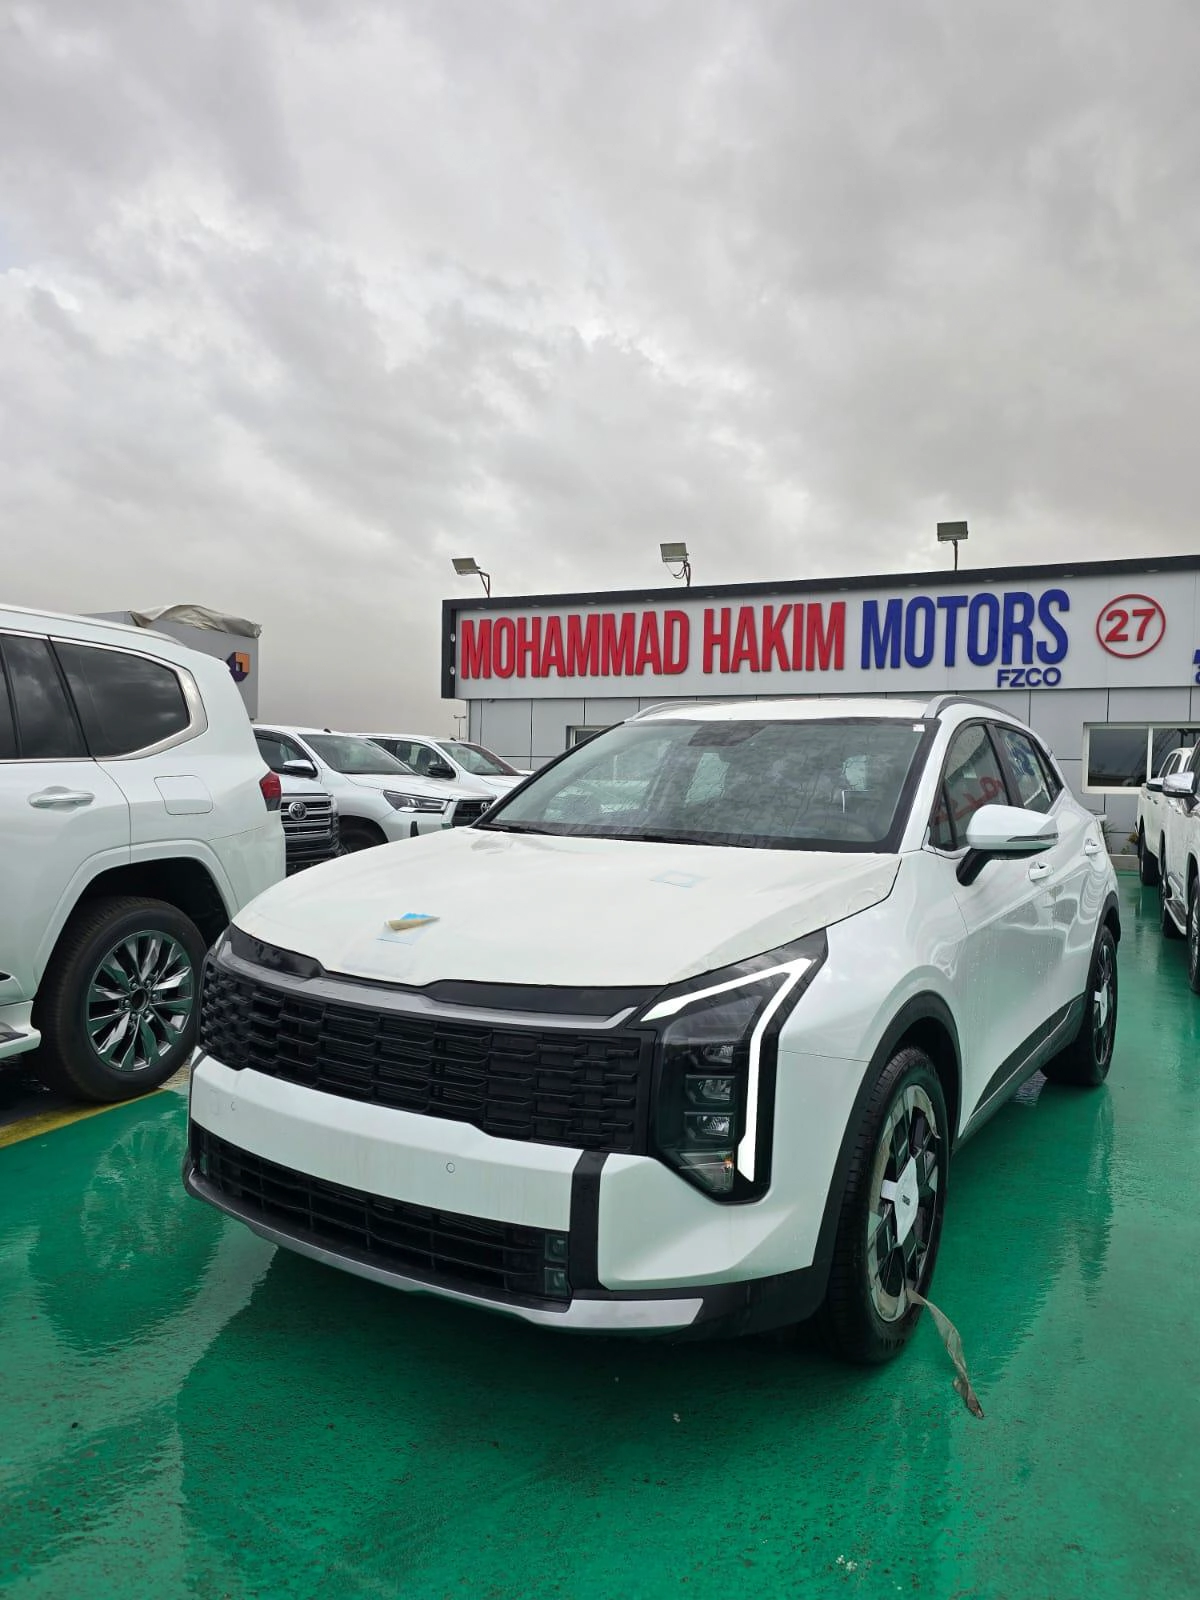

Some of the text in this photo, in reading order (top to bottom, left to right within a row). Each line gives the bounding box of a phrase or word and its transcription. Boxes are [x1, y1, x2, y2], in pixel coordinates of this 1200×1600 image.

[461, 589, 1070, 680] MOHAMMAD HAKIM MOTORS
[1105, 608, 1156, 642] 27
[997, 667, 1062, 688] FZCO
